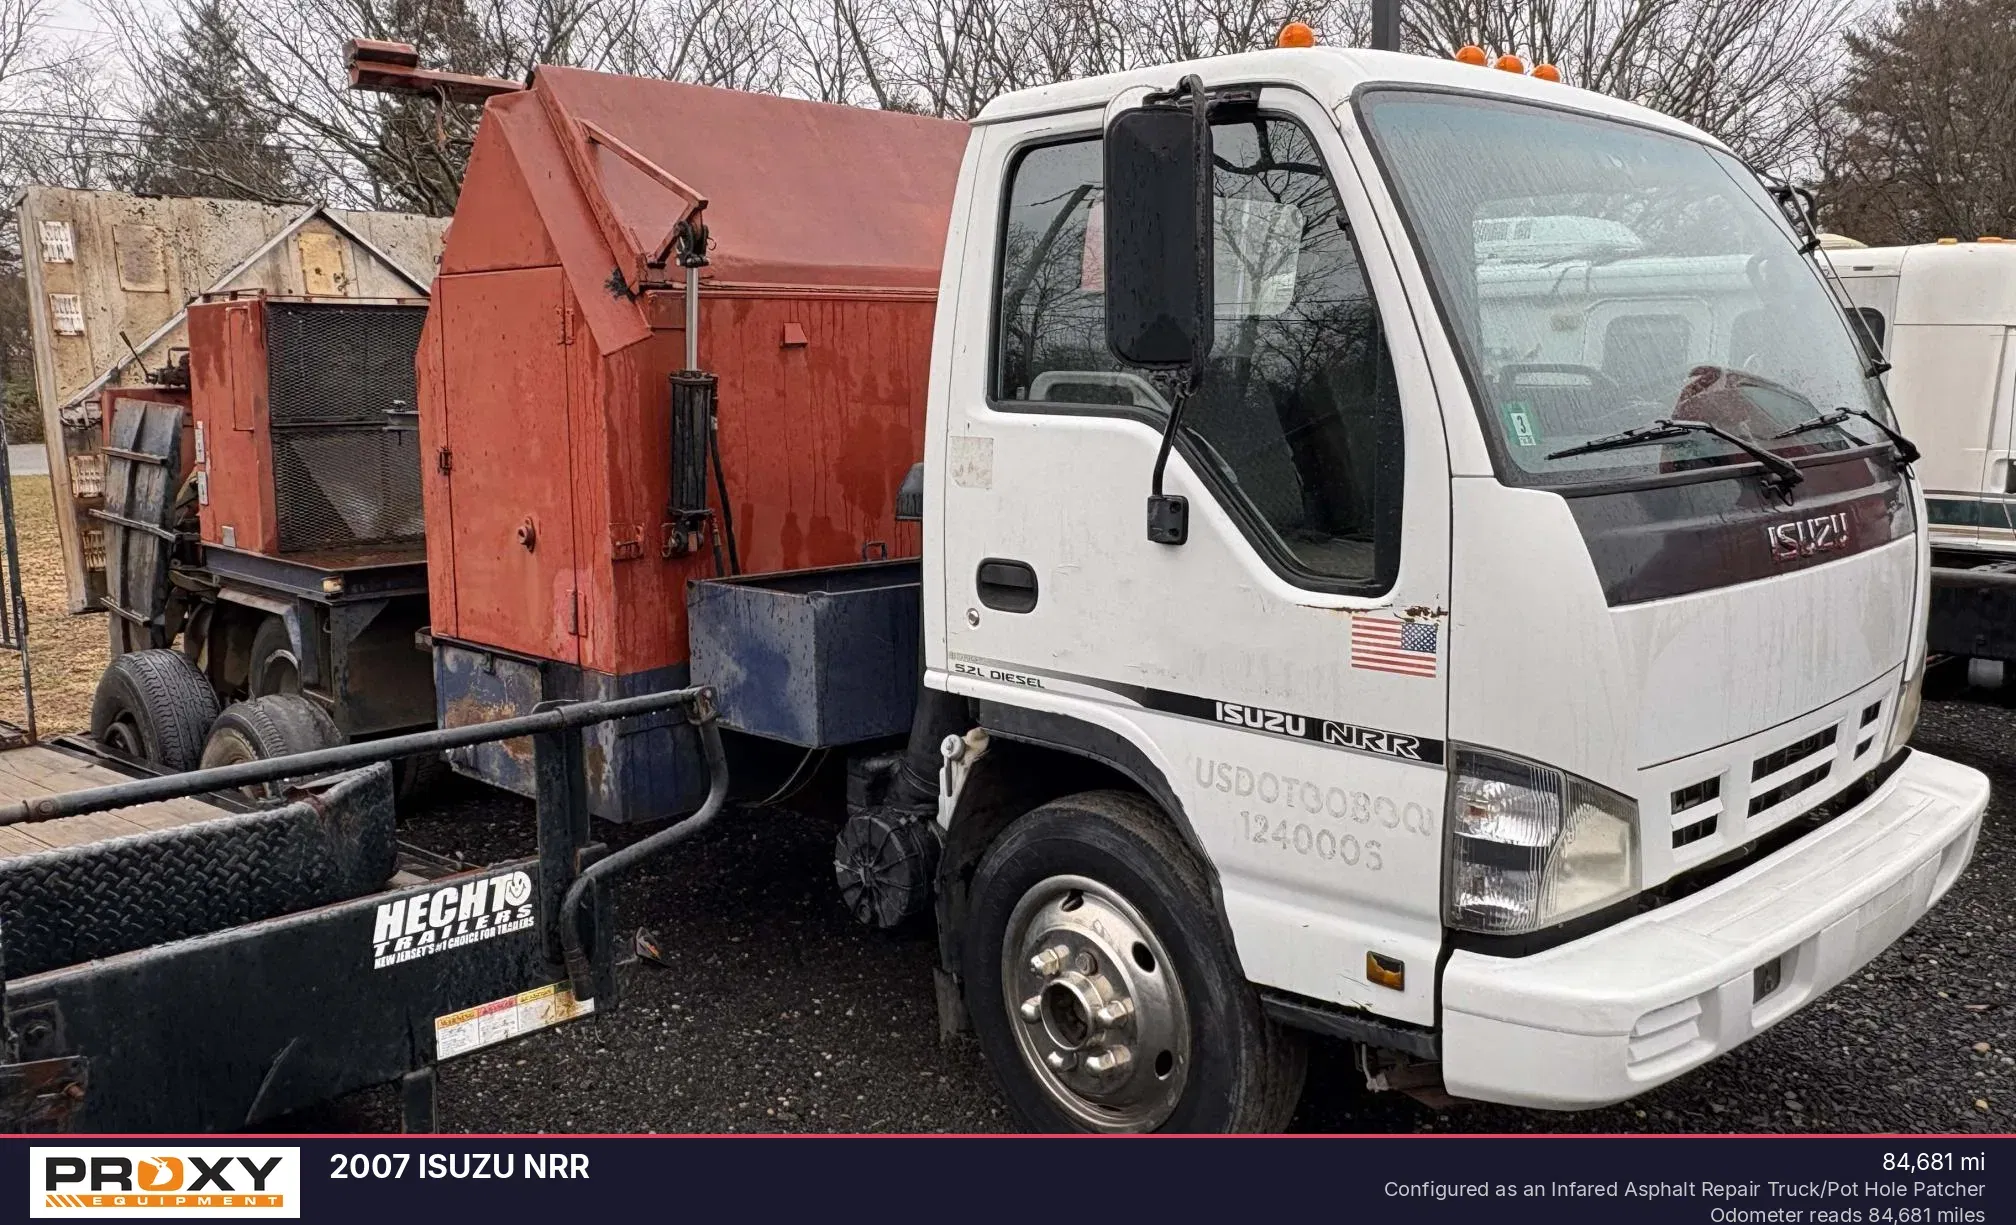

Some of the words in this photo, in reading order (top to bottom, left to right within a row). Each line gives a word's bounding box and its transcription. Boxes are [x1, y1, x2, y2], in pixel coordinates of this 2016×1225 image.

[1767, 512, 1849, 562] ISUZU
[990, 670, 1045, 689] DIESEL
[1215, 701, 1306, 738] ISUZU
[1322, 720, 1422, 761] NRR
[372, 871, 515, 944] HECHT
[374, 903, 534, 957] TRAILERS
[374, 954, 396, 970] NEW
[448, 930, 480, 949] CHOICE
[480, 927, 497, 941] FOR
[495, 916, 535, 935] TRAILERS
